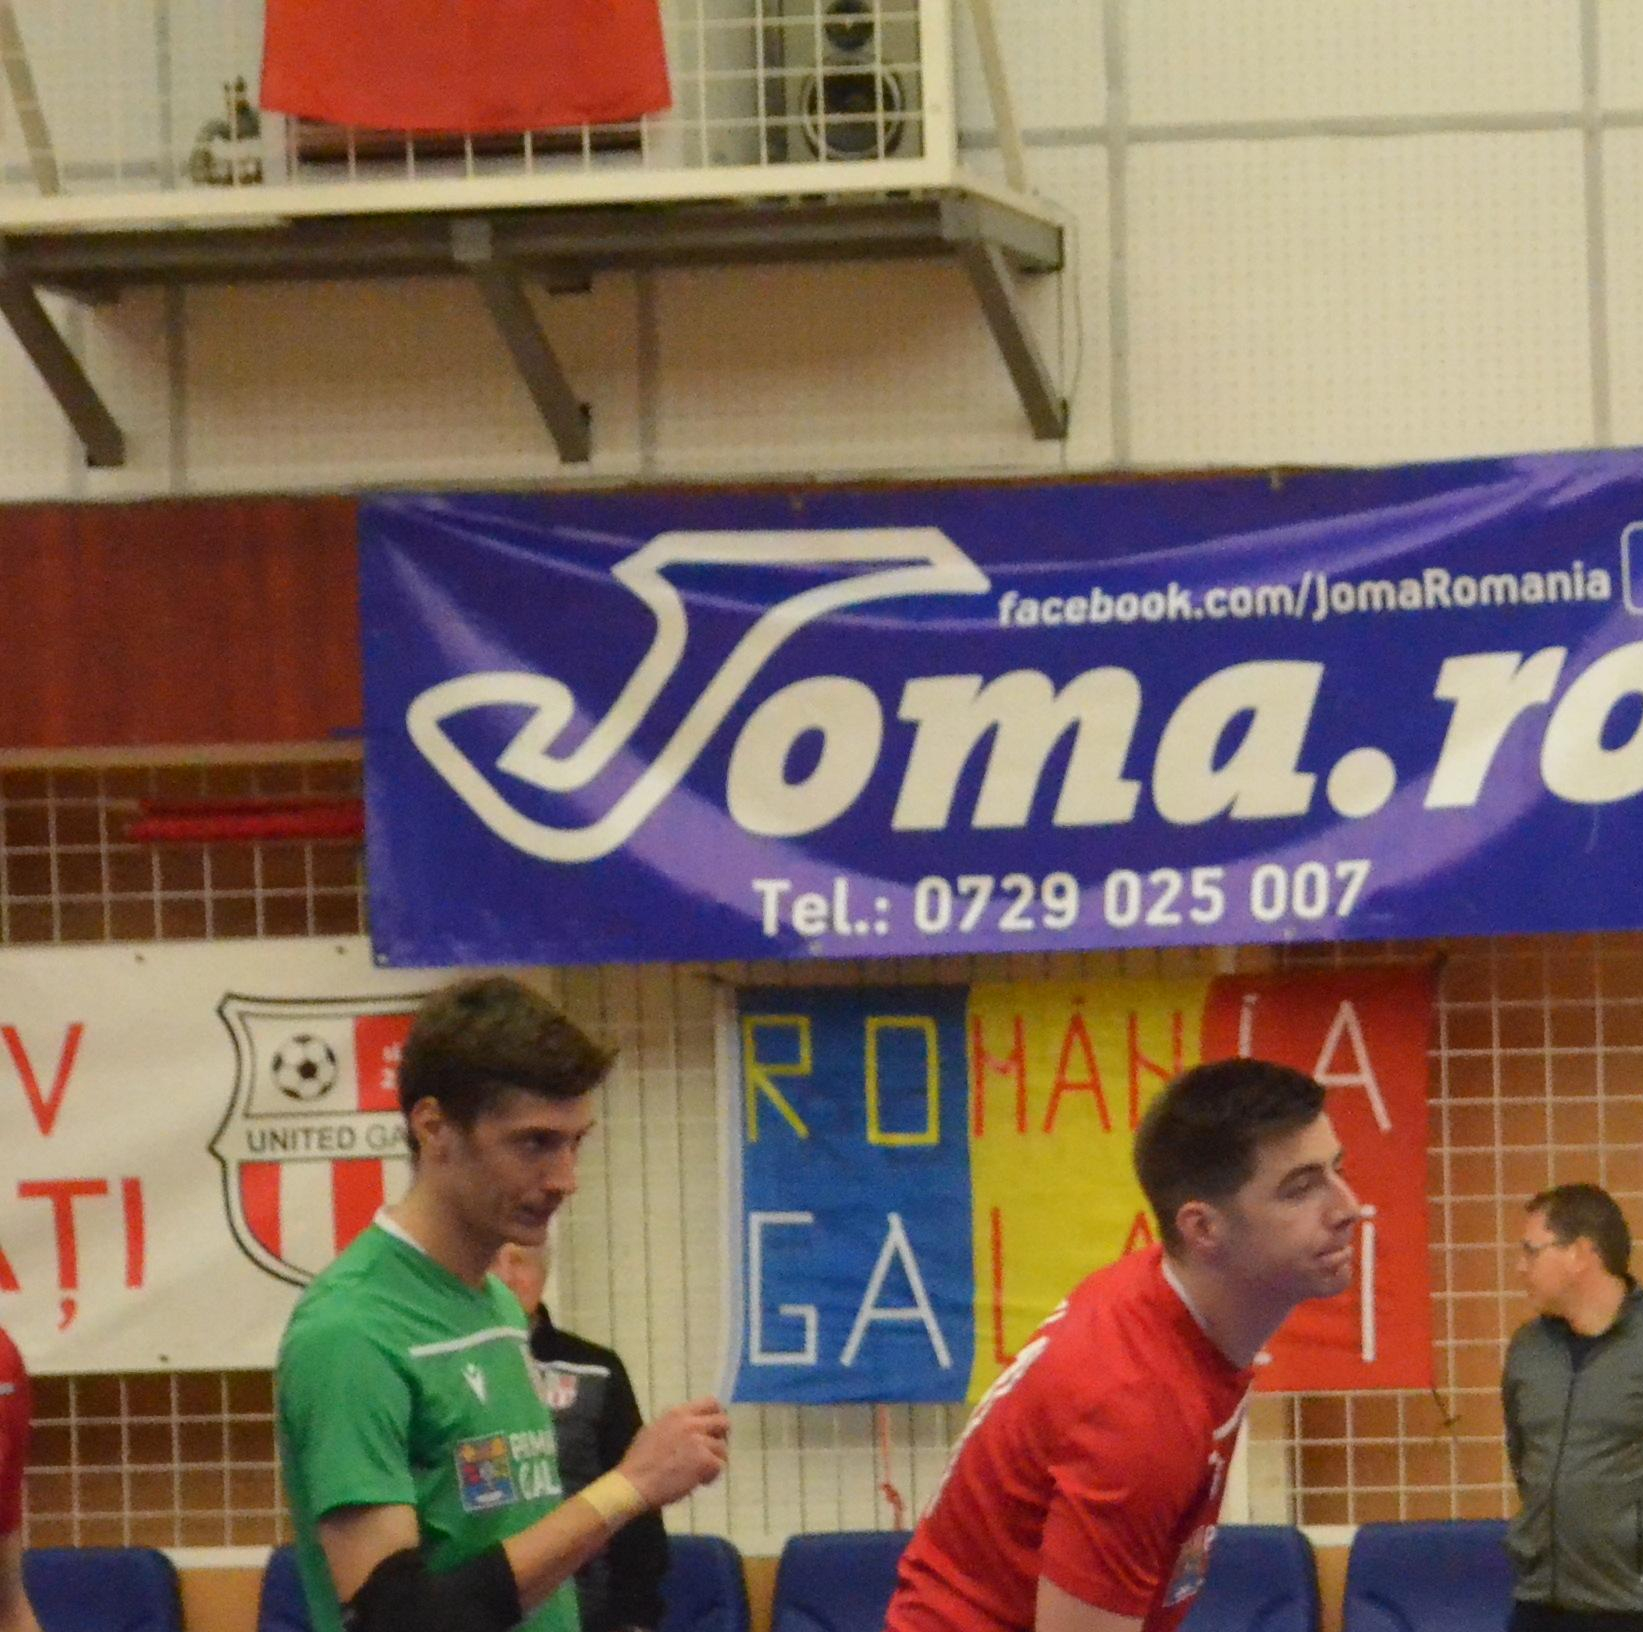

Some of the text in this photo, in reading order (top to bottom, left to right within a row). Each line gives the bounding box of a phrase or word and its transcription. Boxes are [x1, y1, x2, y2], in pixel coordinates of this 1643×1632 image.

[998, 559, 1611, 628] facebook.com/JomaRomania
[751, 858, 1372, 938] Tel.: 0729 025 007
[247, 1126, 356, 1151] UNITED
[0, 1174, 144, 1331] ȚI
